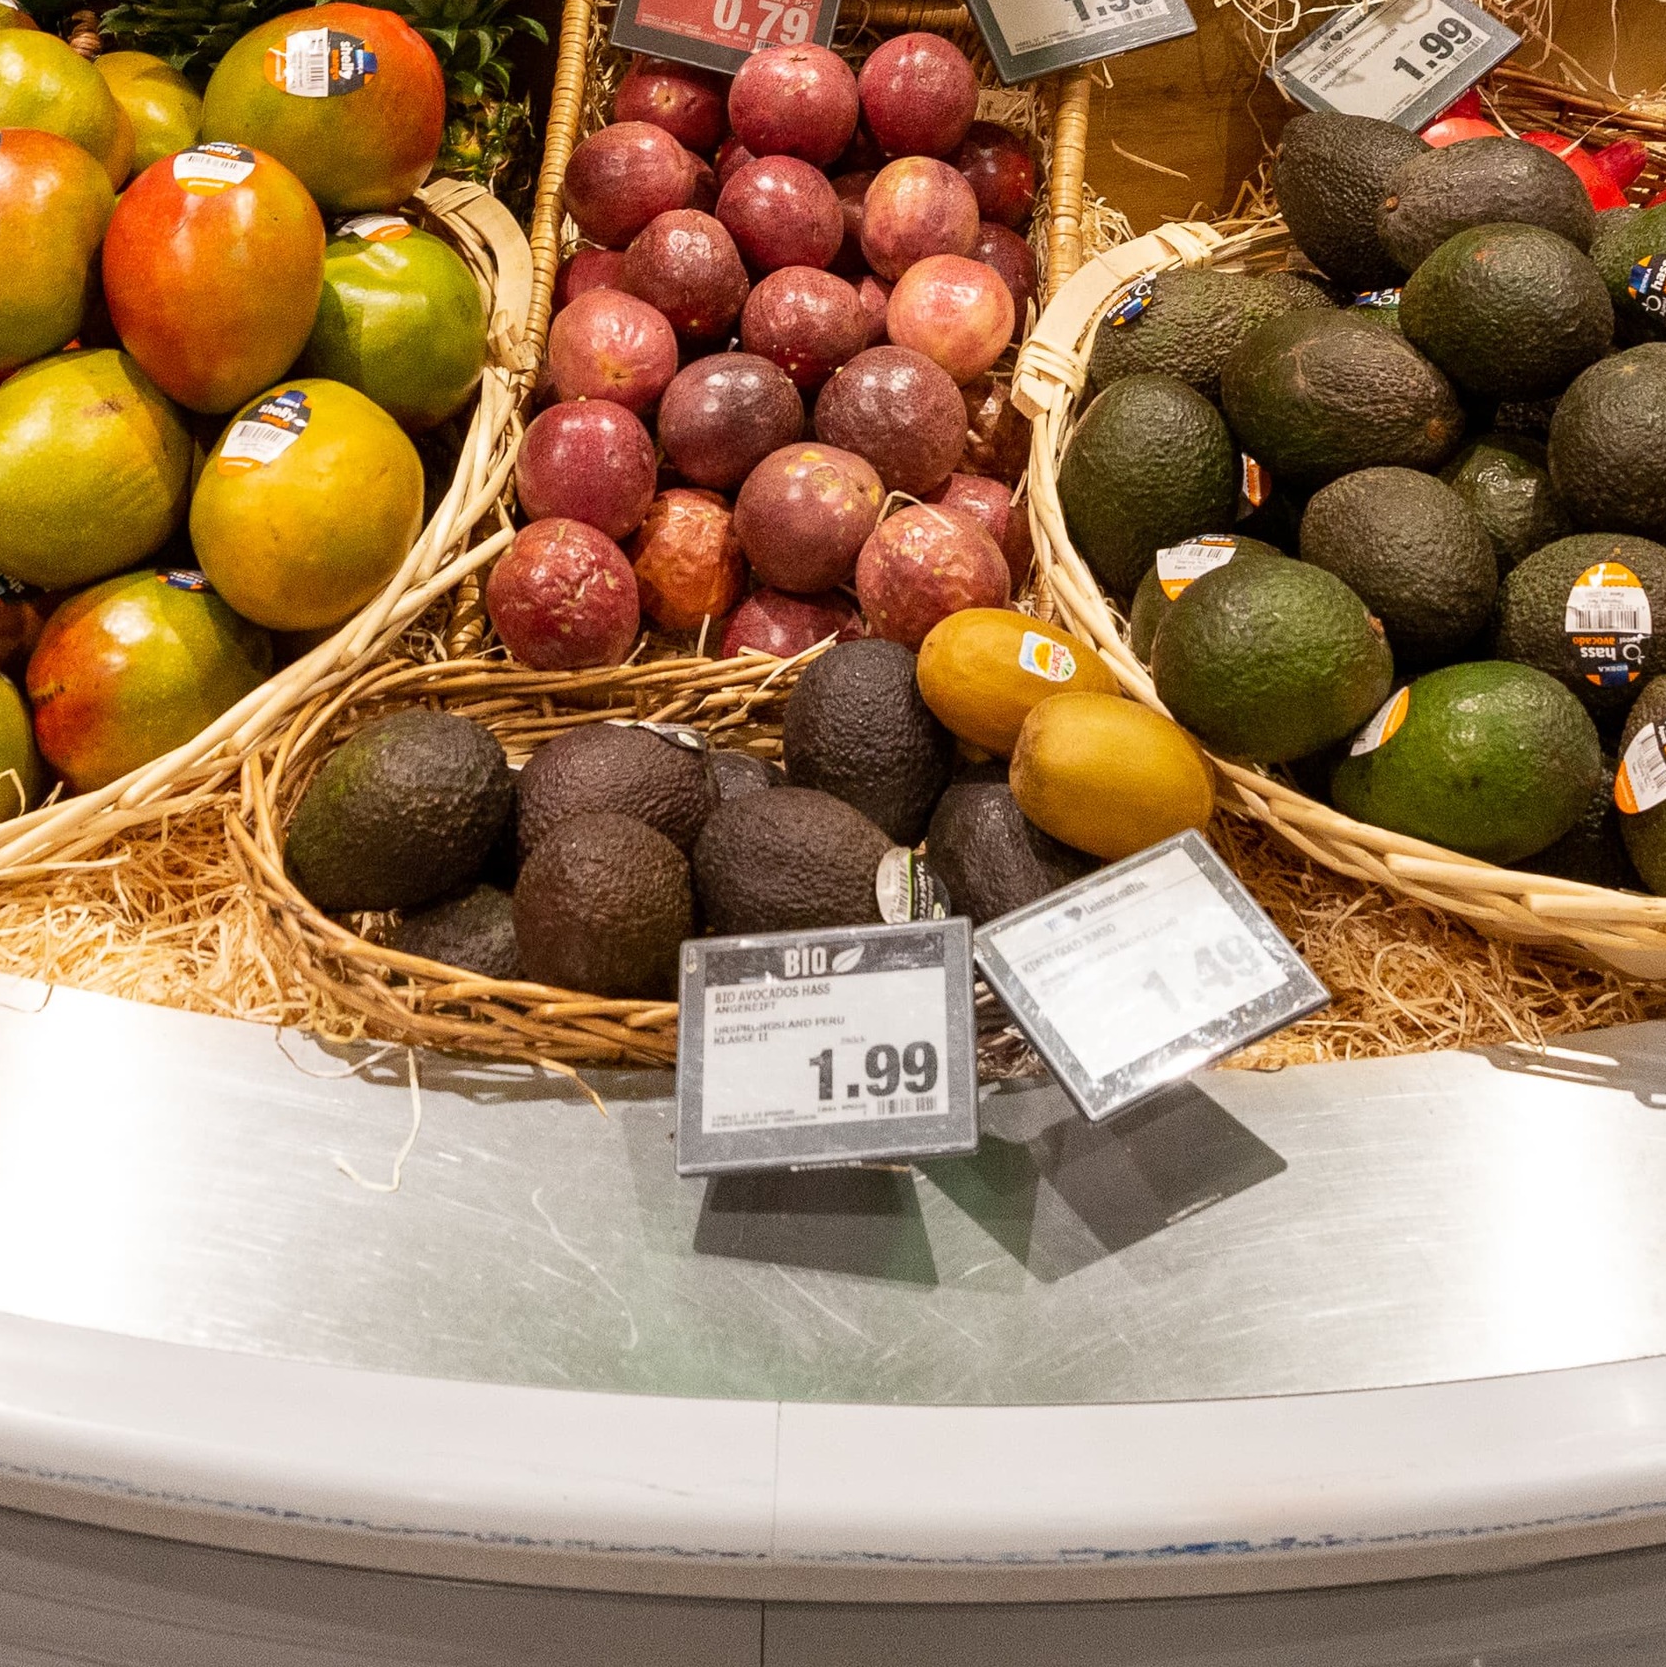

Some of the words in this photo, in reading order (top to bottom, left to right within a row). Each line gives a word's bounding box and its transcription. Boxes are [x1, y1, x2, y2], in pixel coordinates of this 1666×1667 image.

[339, 40, 355, 80] shelly
[1393, 17, 1473, 82] 1.99
[258, 403, 298, 422] shelly
[1579, 646, 1617, 661] hass
[783, 946, 828, 979] BIO
[715, 991, 736, 1005] BIO
[738, 987, 800, 1003] AVOCADOS
[801, 983, 831, 997] HASS
[714, 1001, 777, 1015] ANGEREIFT
[814, 1016, 846, 1027] PERU
[809, 1041, 939, 1101] 1.99
